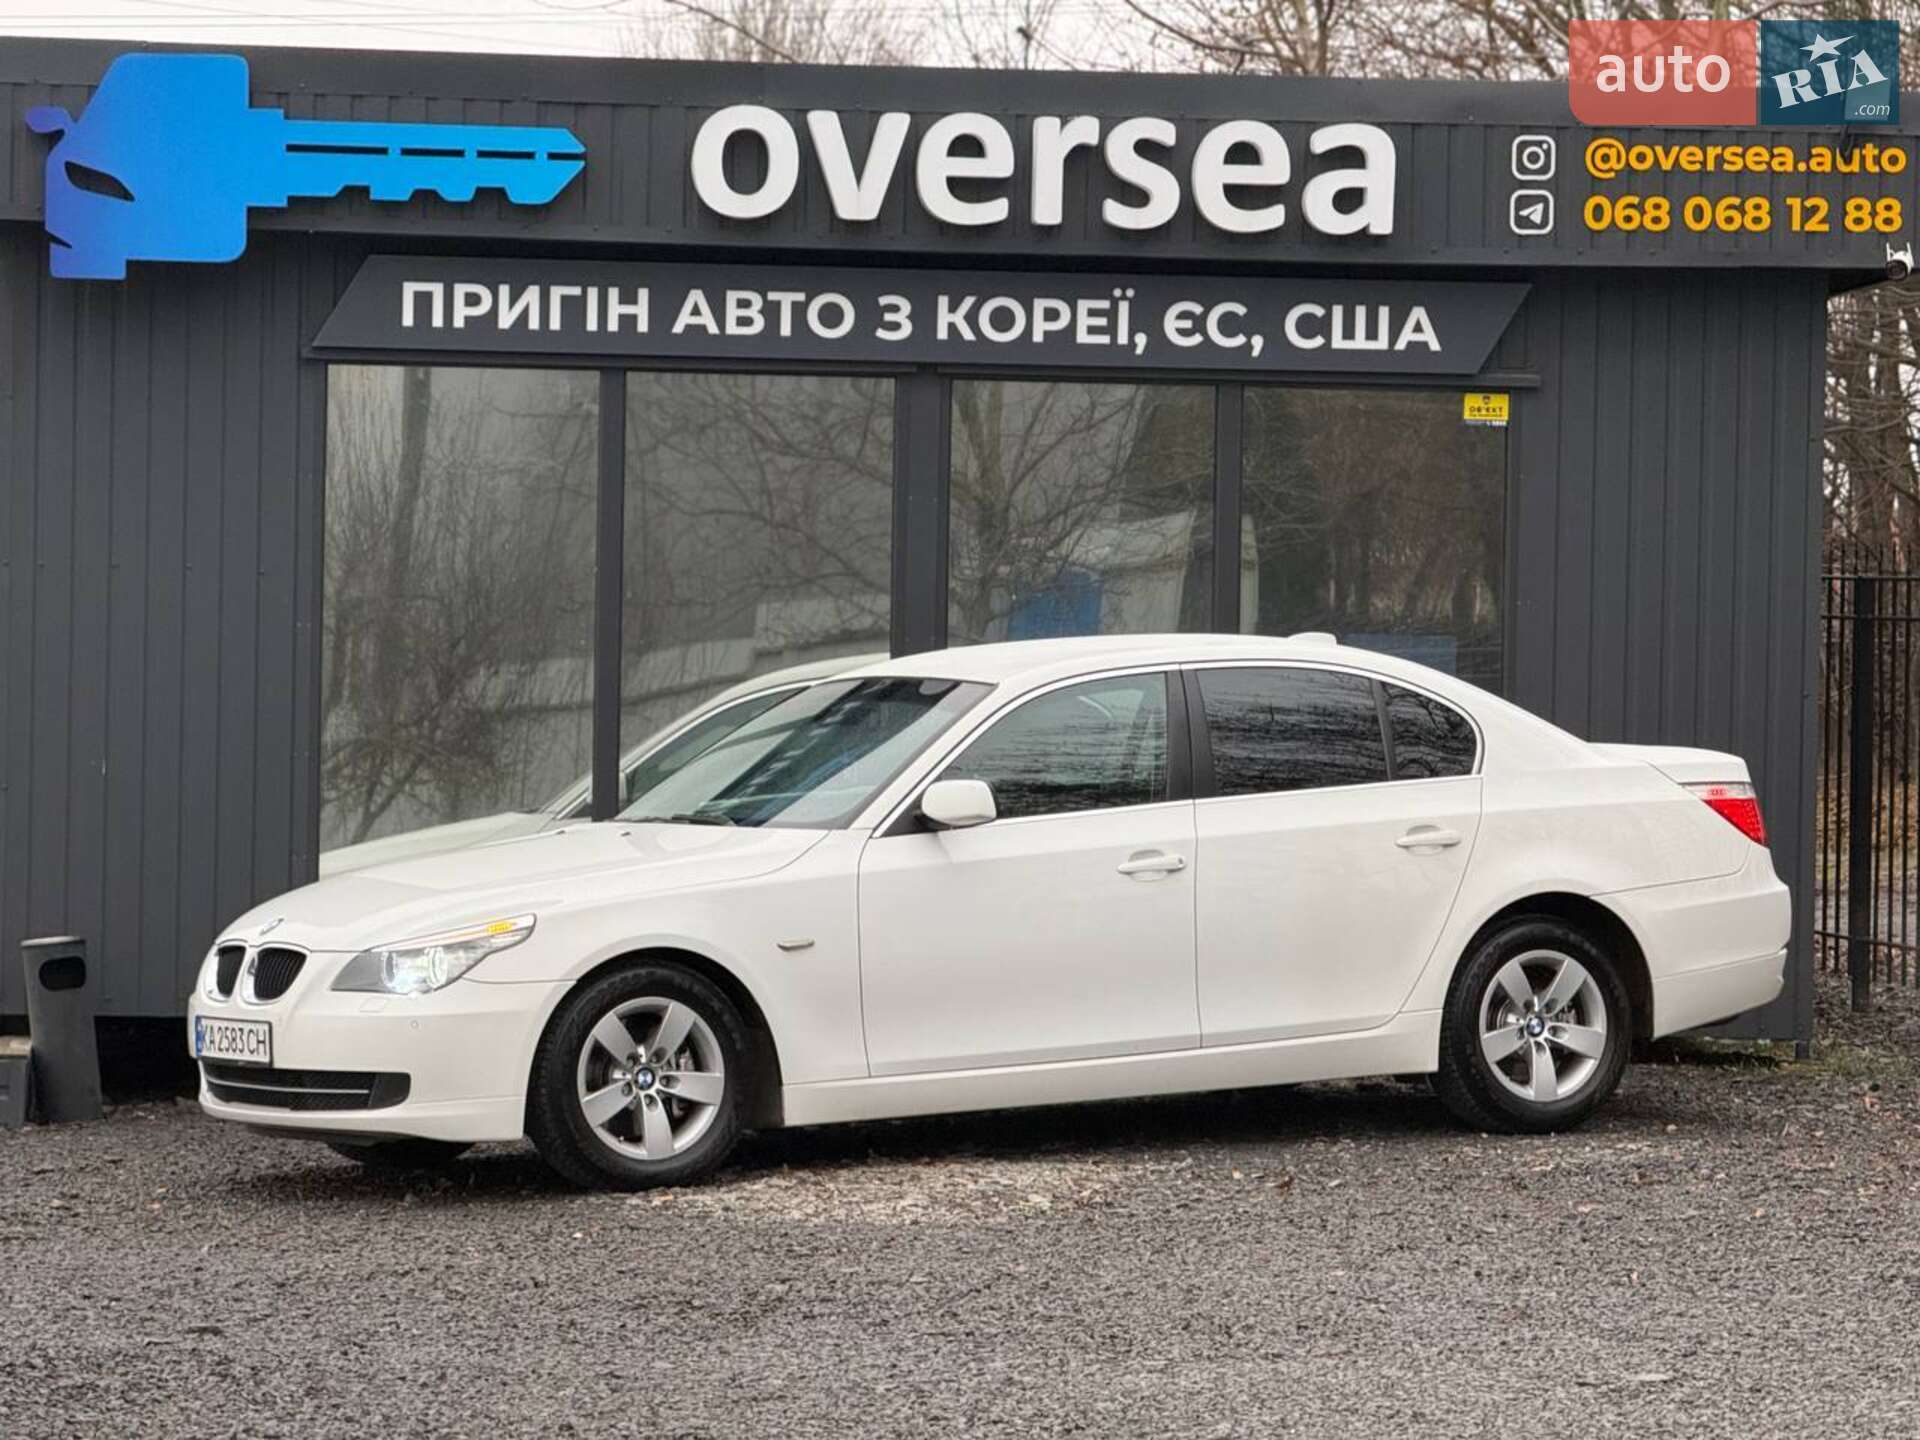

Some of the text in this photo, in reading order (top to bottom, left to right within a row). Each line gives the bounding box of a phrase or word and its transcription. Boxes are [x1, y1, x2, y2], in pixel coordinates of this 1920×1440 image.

[691, 104, 1397, 235] oversea
[1584, 137, 1908, 180] @oversea.auto
[1583, 195, 1903, 233] 068 068 12 88
[401, 281, 1442, 358] ПРИГІН АВТО З КОРЕЇ, ЄС, США
